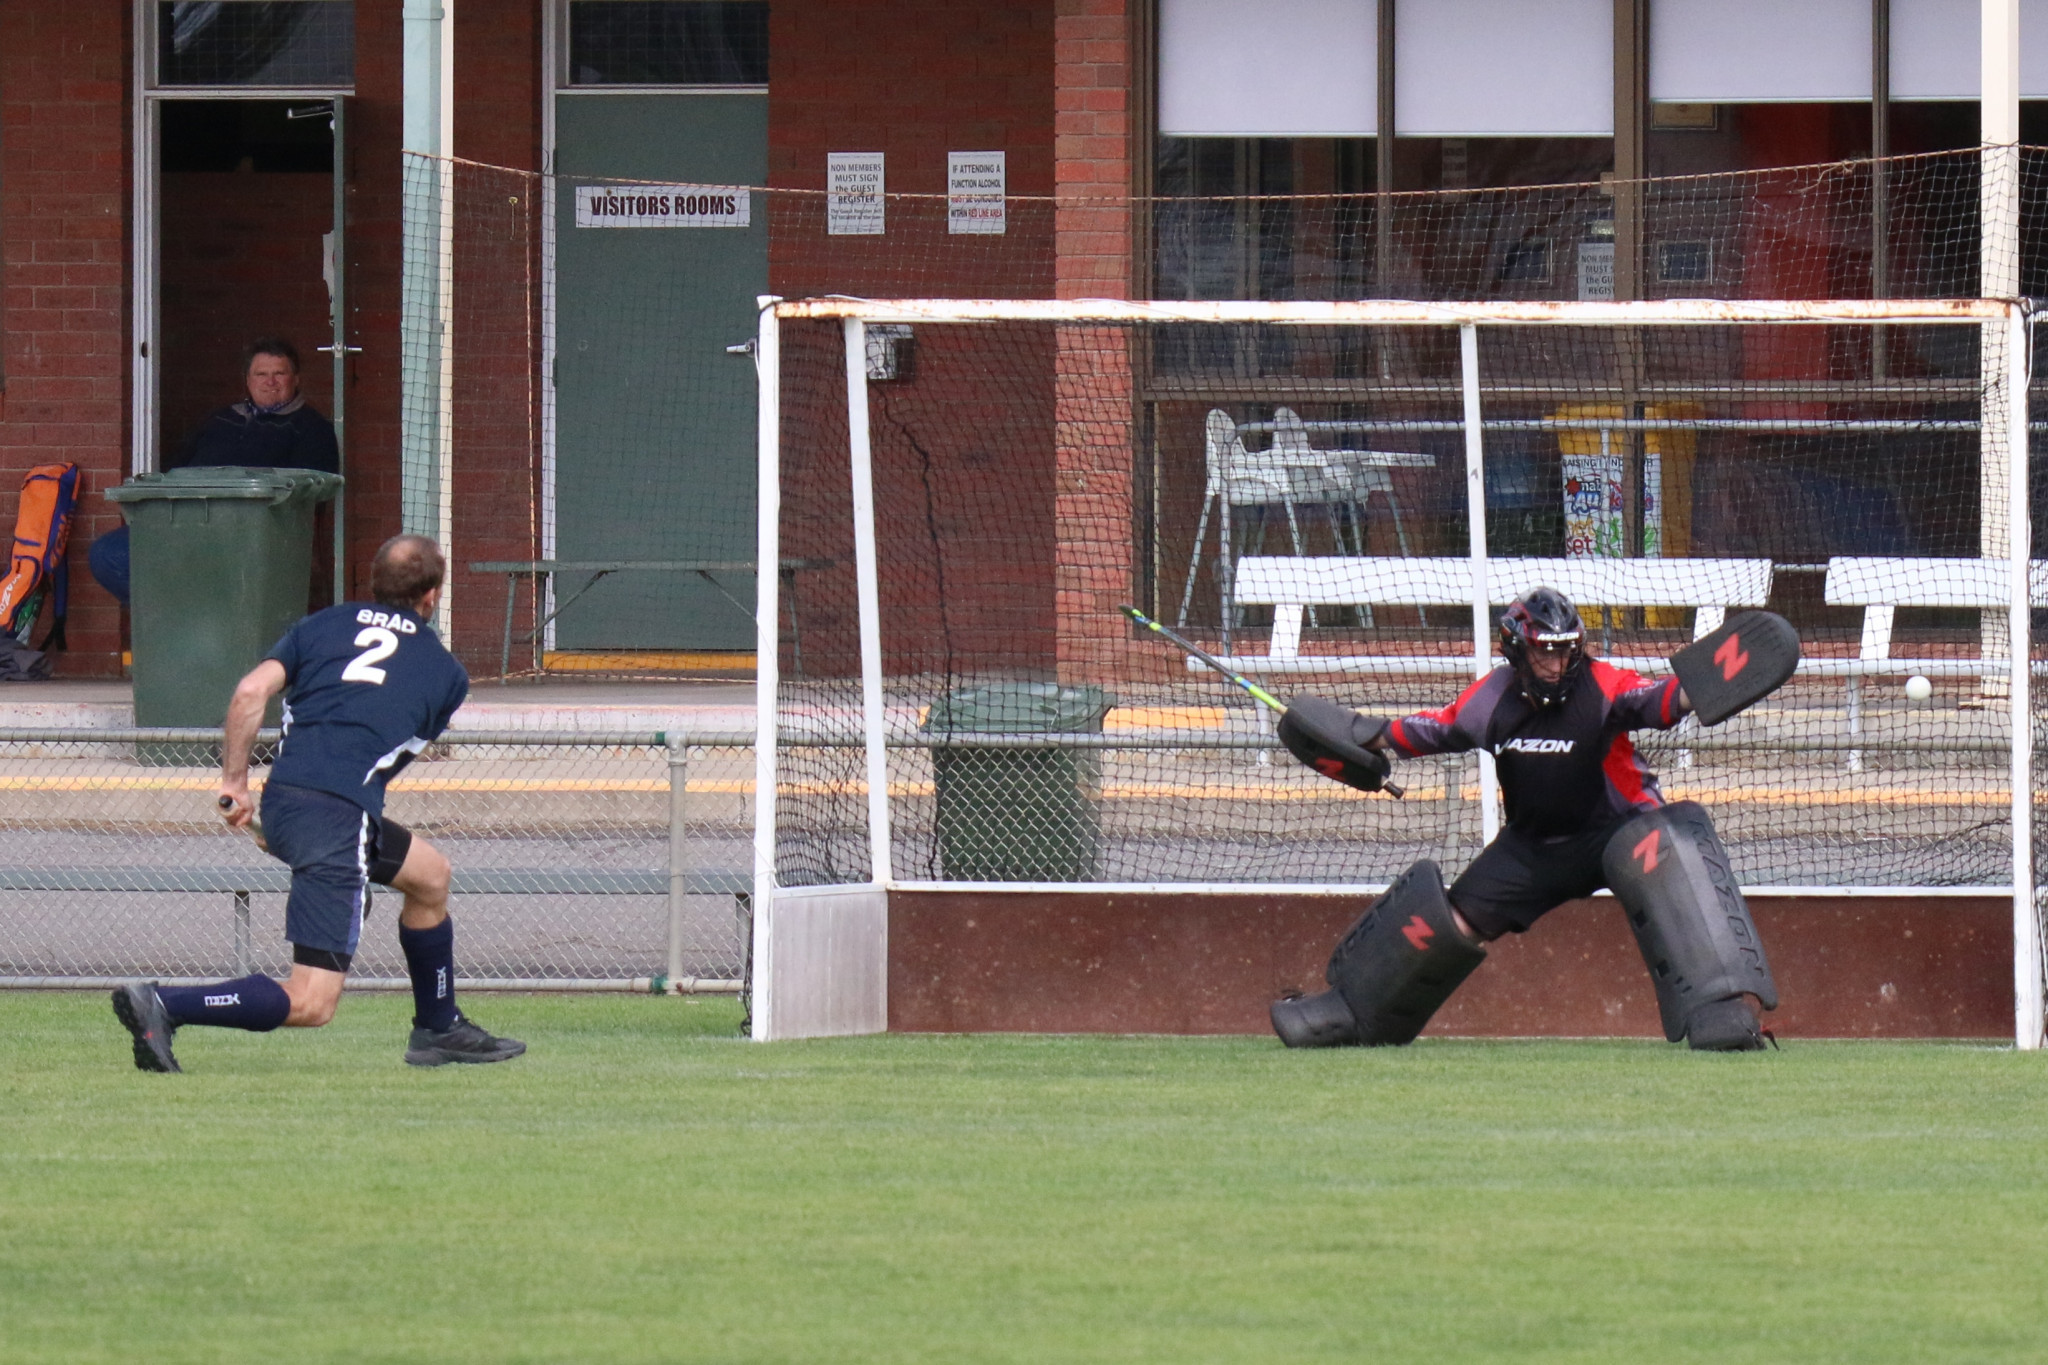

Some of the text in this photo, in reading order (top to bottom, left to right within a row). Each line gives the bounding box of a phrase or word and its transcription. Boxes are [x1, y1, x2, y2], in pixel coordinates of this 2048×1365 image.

[831, 164, 882, 172] NON MEMBERS
[953, 165, 1001, 173] IF ATTENDING A
[835, 174, 878, 182] MUST SIGN
[951, 180, 1001, 188] FUNCTION ALCOHOL
[838, 195, 875, 204] REGISTER
[590, 195, 736, 216] VISITORS ROOMS
[1586, 265, 1607, 273] MUST
[356, 608, 417, 635] BRAD
[341, 626, 399, 686] 2
